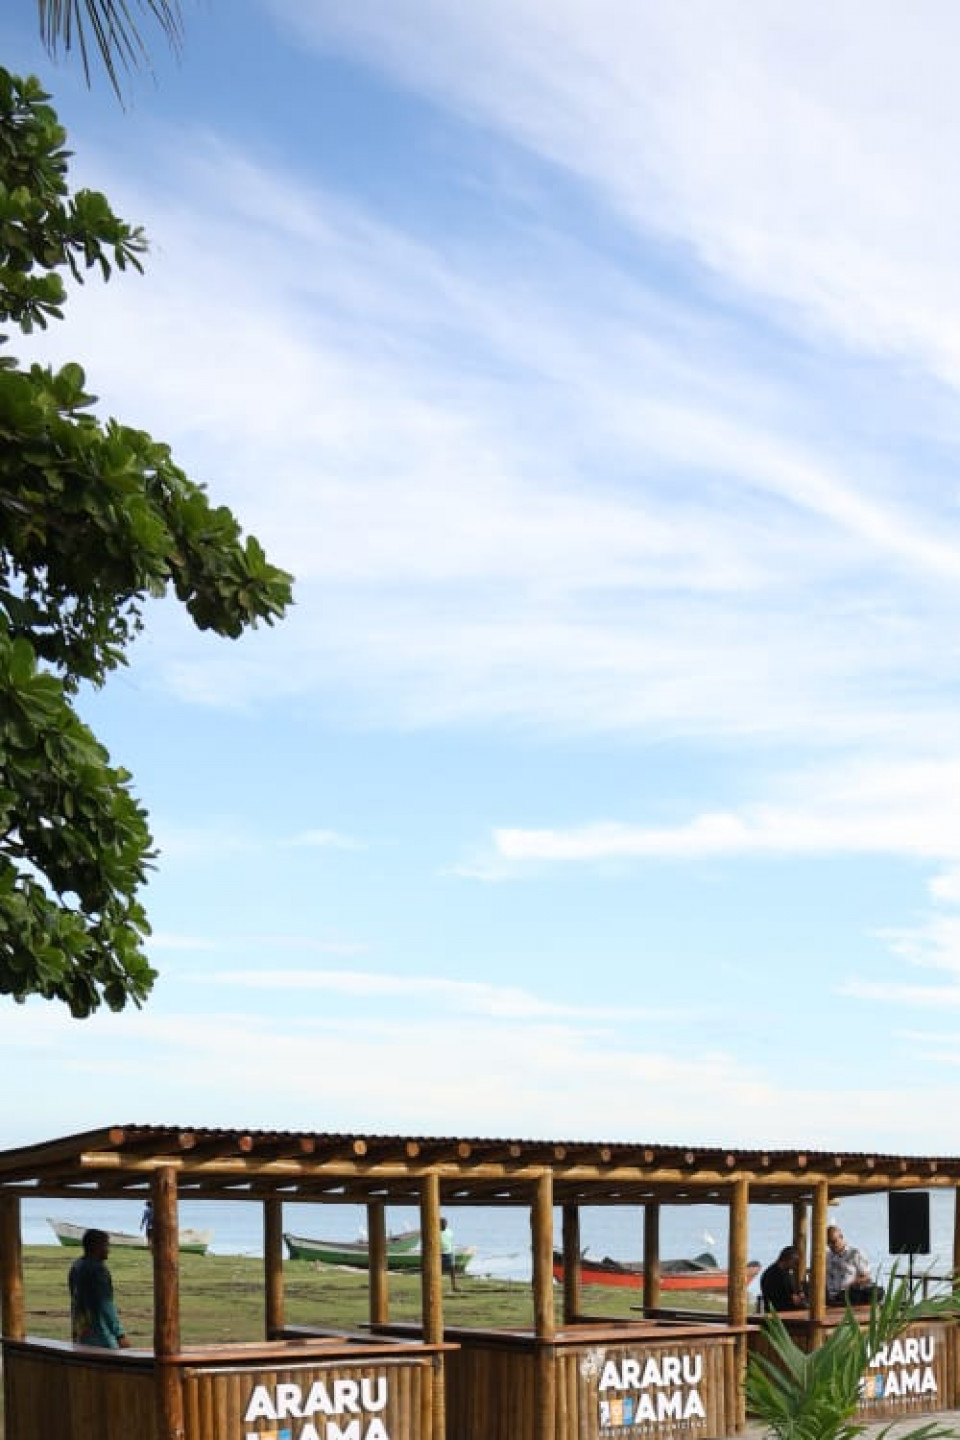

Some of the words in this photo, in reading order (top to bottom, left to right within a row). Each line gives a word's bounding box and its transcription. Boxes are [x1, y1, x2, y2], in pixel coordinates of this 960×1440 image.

[598, 1353, 702, 1391] ARARU
[884, 1366, 938, 1397] AMA
[244, 1376, 387, 1421] ARARU
[635, 1389, 707, 1424] AMA
